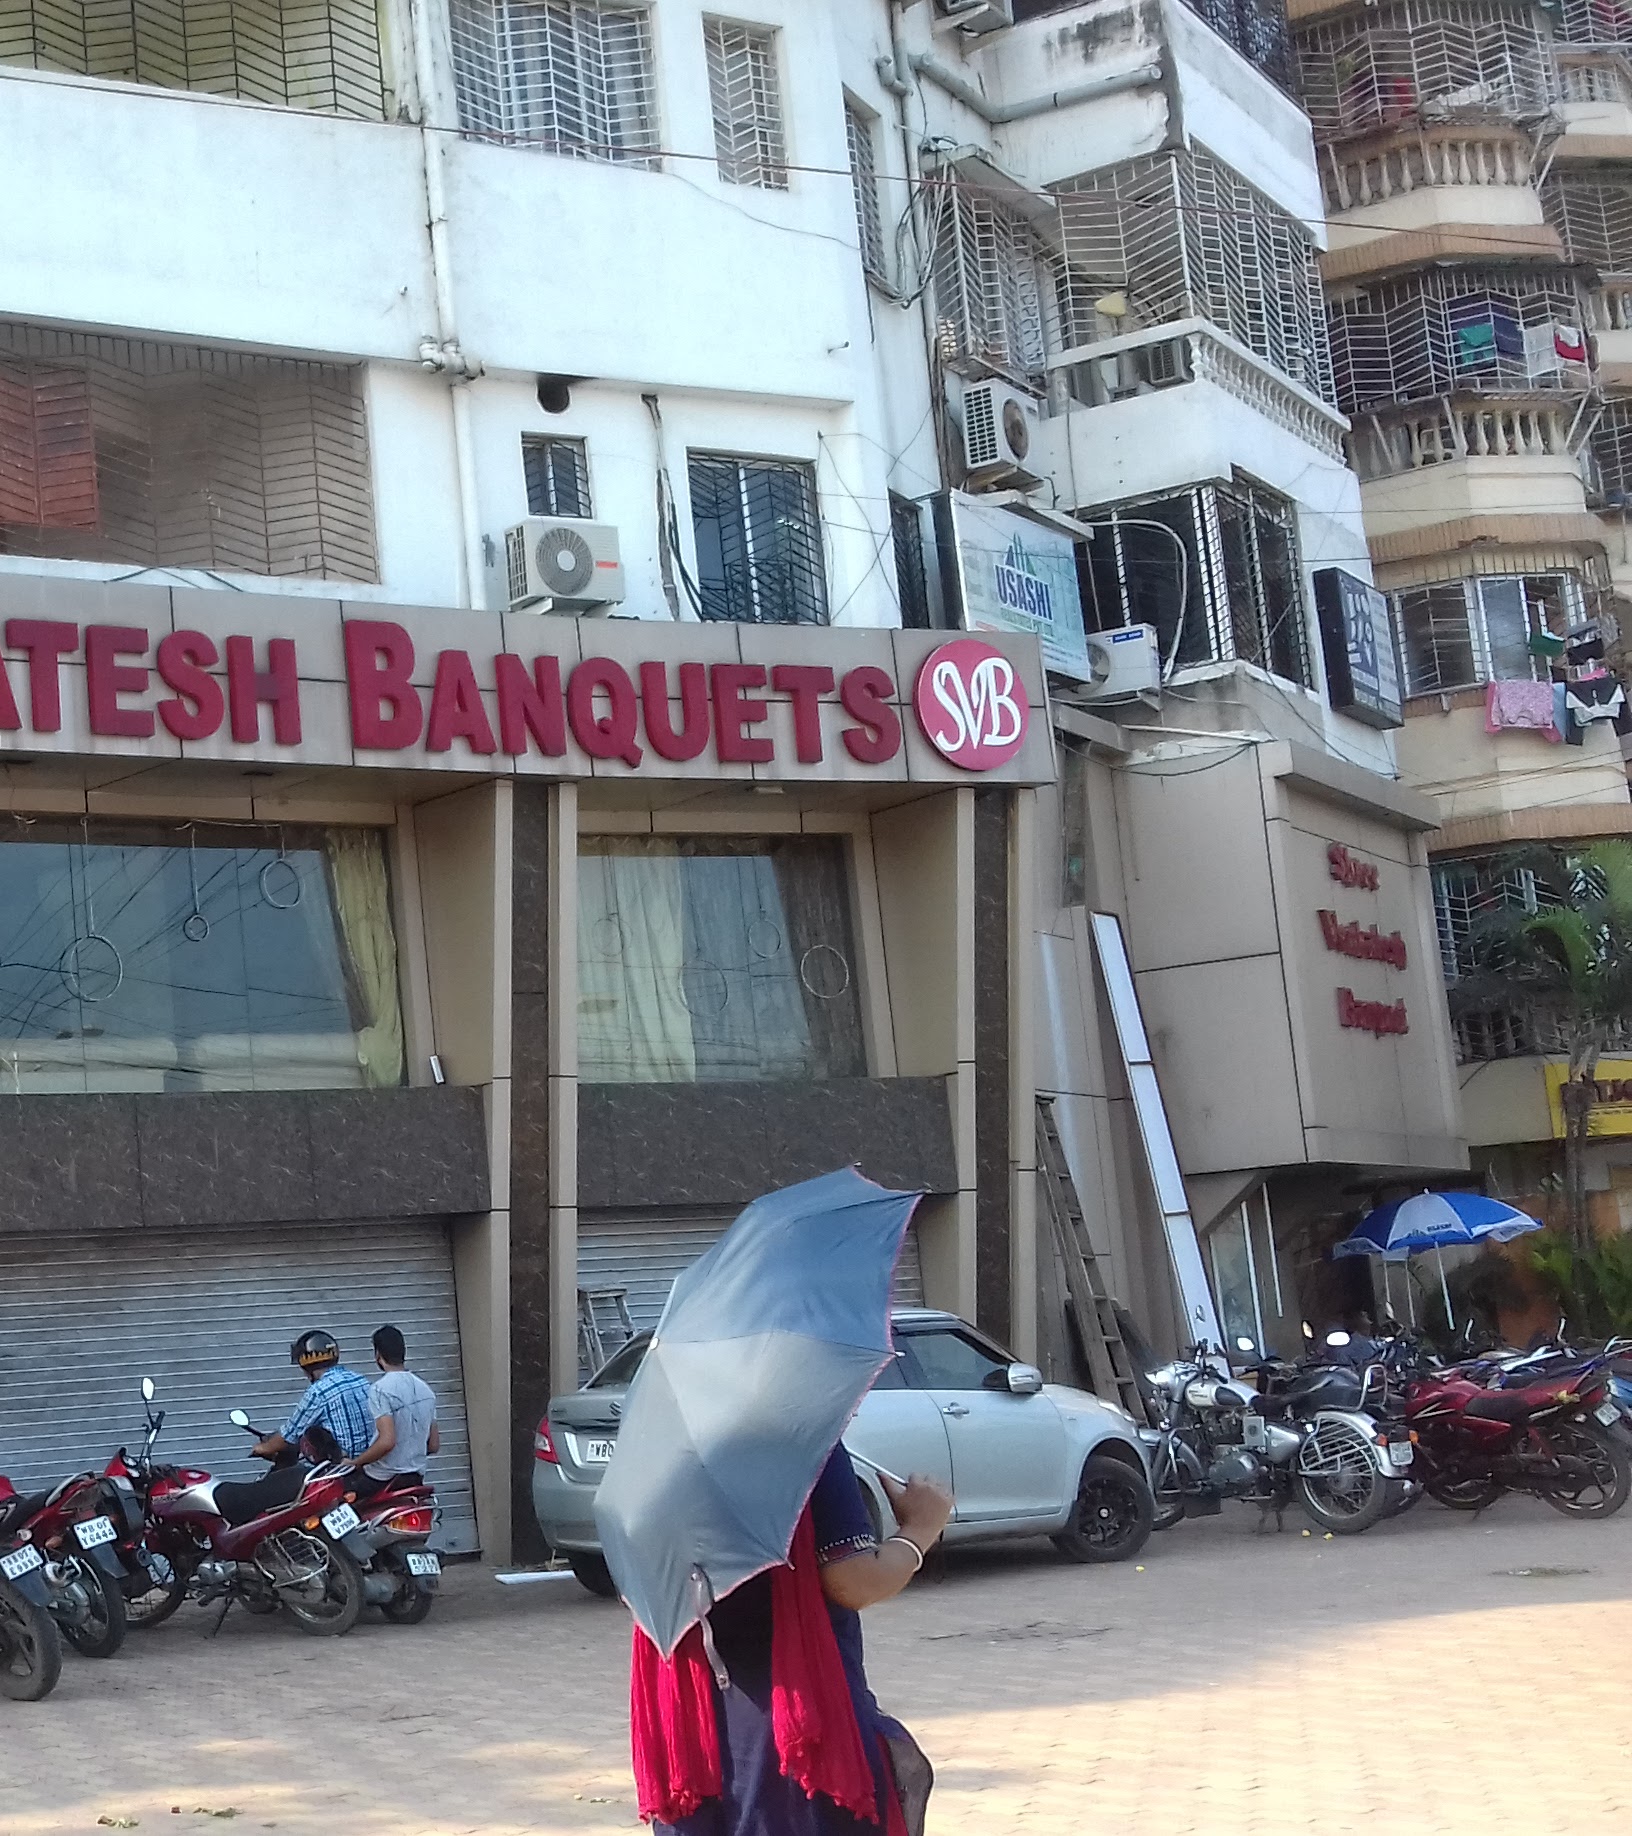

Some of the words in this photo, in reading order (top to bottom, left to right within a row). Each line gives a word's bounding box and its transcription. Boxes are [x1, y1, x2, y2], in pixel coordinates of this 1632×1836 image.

[994, 565, 1054, 621] USASHI
[343, 619, 900, 768] BANQUETS
[932, 657, 1022, 752] SVB
